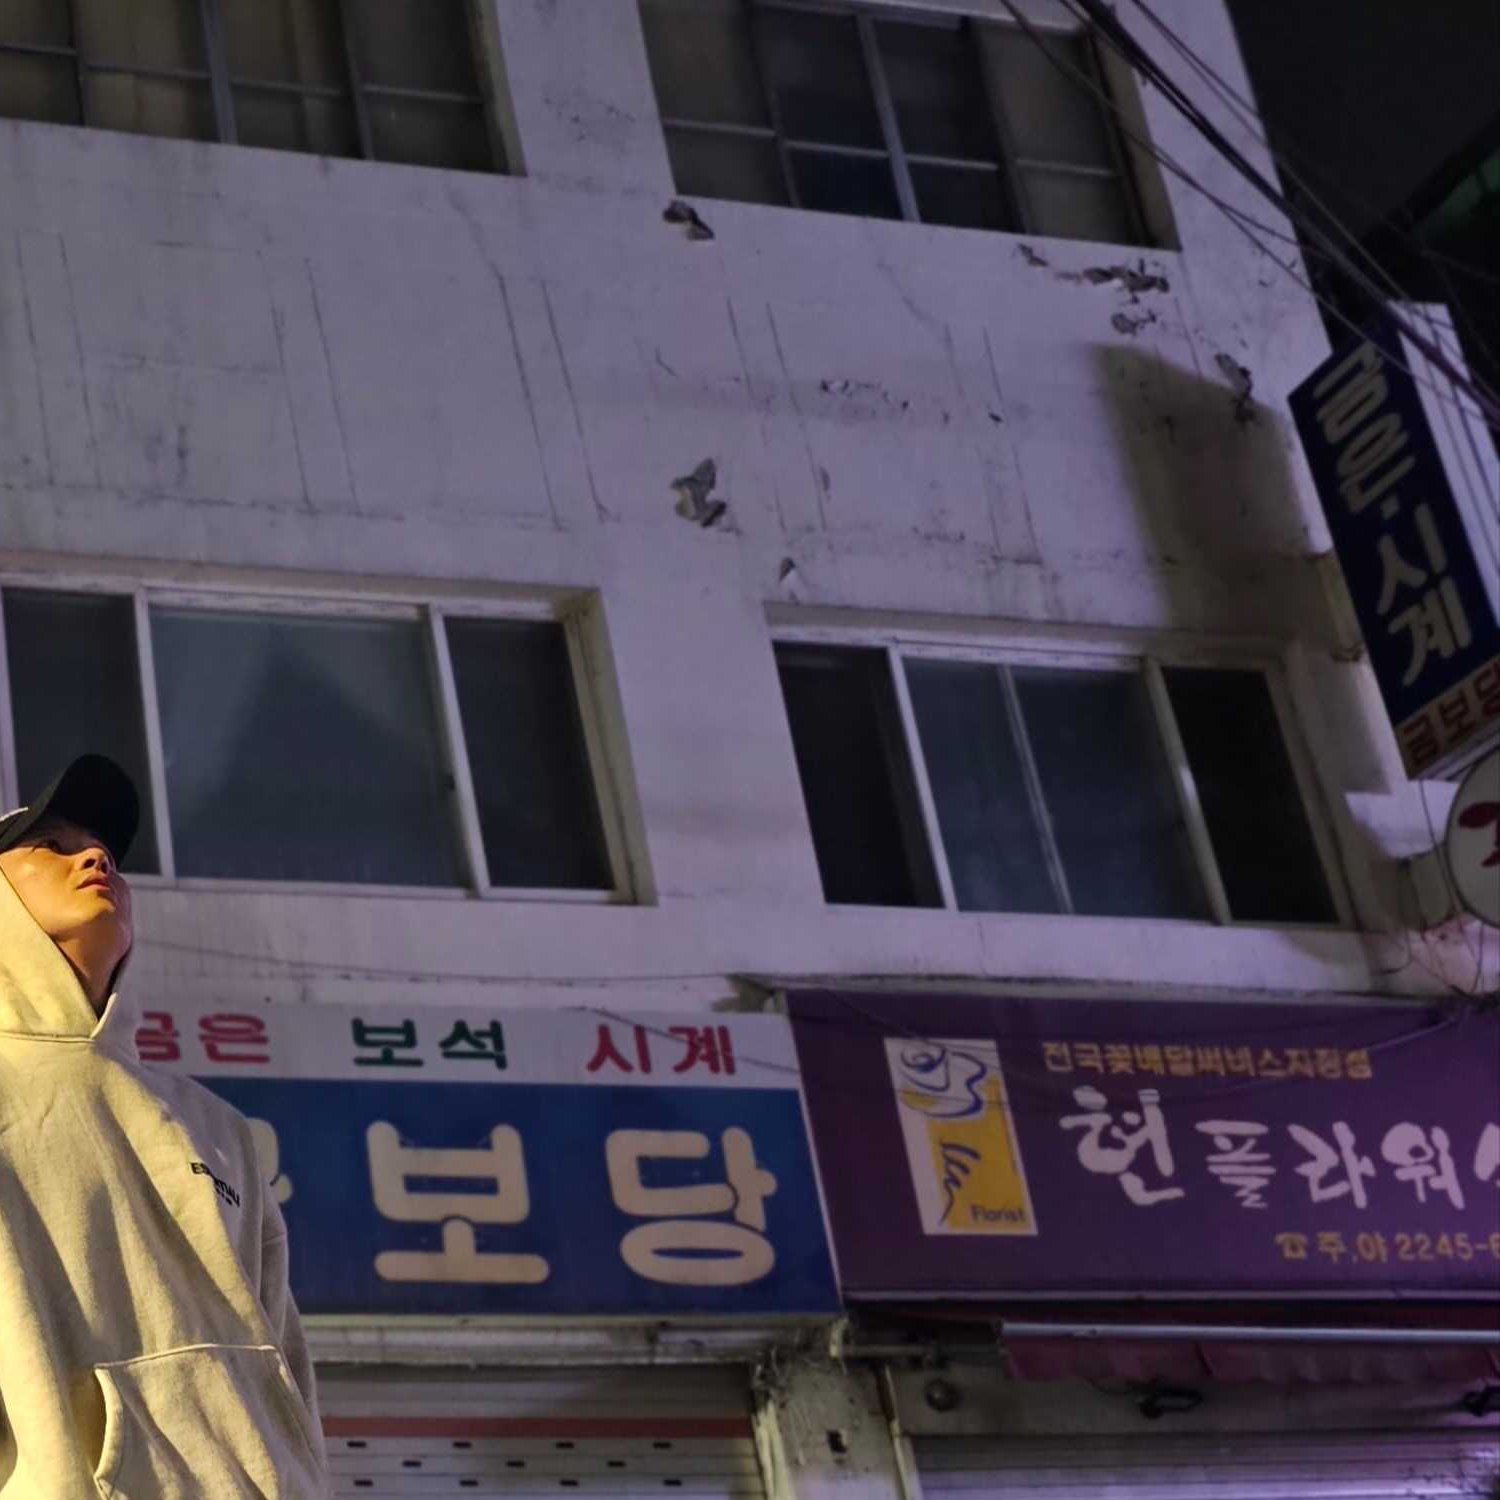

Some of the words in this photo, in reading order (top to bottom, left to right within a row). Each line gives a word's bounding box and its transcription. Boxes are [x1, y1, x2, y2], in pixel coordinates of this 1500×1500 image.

[351, 1017, 508, 1070] 보석
[586, 1023, 736, 1076] 시계
[246, 1117, 778, 1287] 보당
[971, 1205, 1026, 1223] Florist
